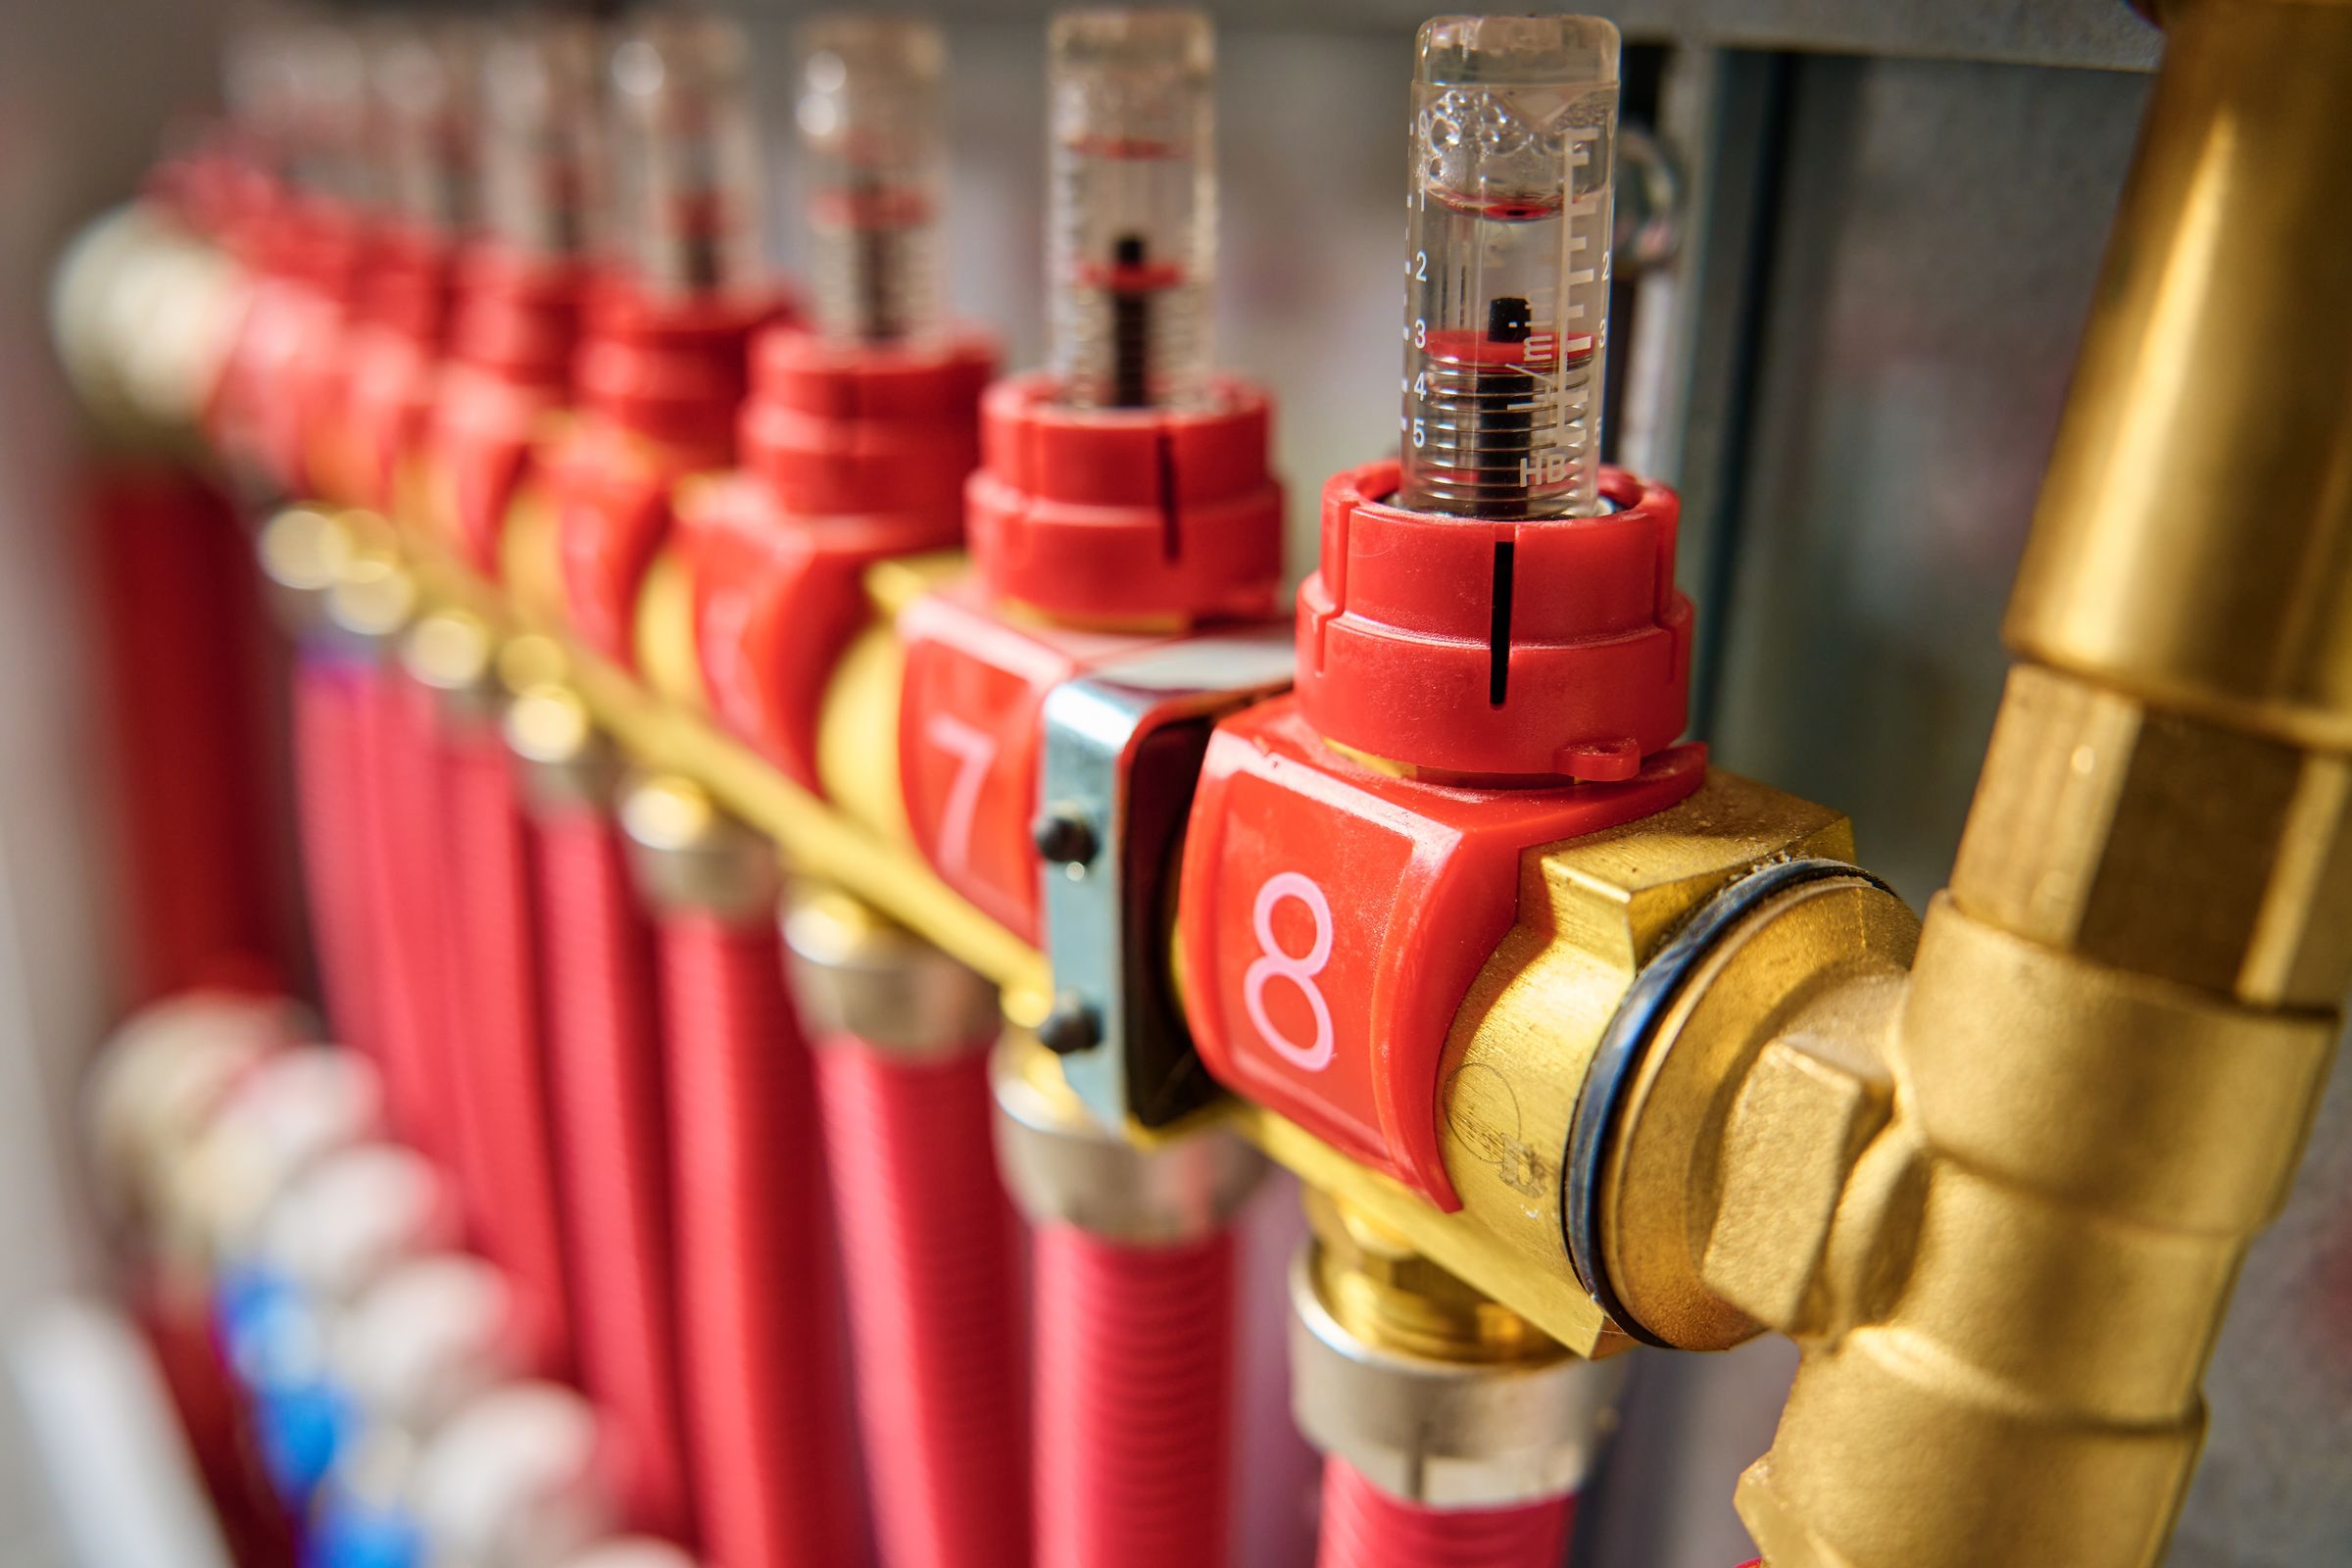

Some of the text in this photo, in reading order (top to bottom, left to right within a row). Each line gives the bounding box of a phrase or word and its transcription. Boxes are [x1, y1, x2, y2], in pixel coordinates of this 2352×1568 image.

[1415, 250, 1428, 282] 2
[1601, 251, 1610, 281] 2
[1415, 318, 1427, 349] 3
[1598, 318, 1606, 349] 3
[1414, 371, 1427, 402] 4
[1413, 416, 1426, 449] 5
[1519, 452, 1567, 488] HB
[923, 710, 996, 876] 7
[1244, 870, 1335, 1073] 8
